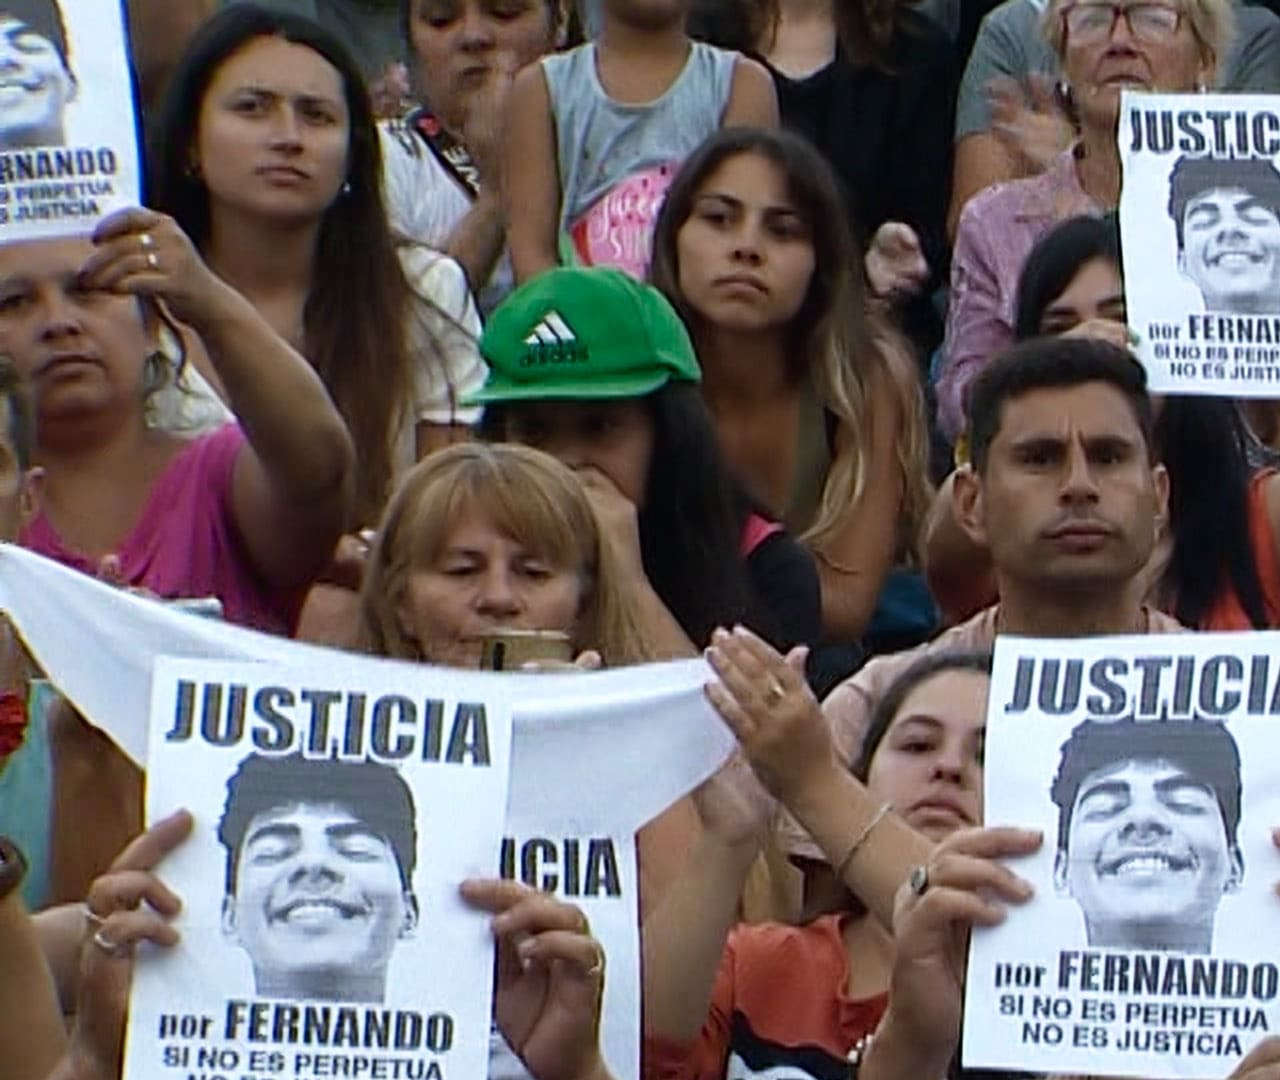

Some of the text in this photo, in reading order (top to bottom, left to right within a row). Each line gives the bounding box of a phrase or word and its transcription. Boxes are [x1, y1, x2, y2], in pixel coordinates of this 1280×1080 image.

[0, 147, 117, 184] RNANDO
[15, 181, 115, 199] PERPETUA
[14, 200, 100, 220] JUSTICIA
[1149, 323, 1181, 341] por
[1170, 363, 1197, 377] NO
[1175, 346, 1201, 360] NO
[165, 678, 492, 767] JUSTICIA
[499, 837, 622, 897] ICIA
[994, 950, 1279, 1001] por FERNANDO
[159, 999, 455, 1054] por FERNANDO
[999, 994, 1269, 1032] SI NO ES PERPETUA
[1021, 1022, 1242, 1056] NO ES JUSTICIA
[163, 1046, 189, 1067] SI
[197, 1049, 240, 1070] NO
[250, 1051, 285, 1072] ES
